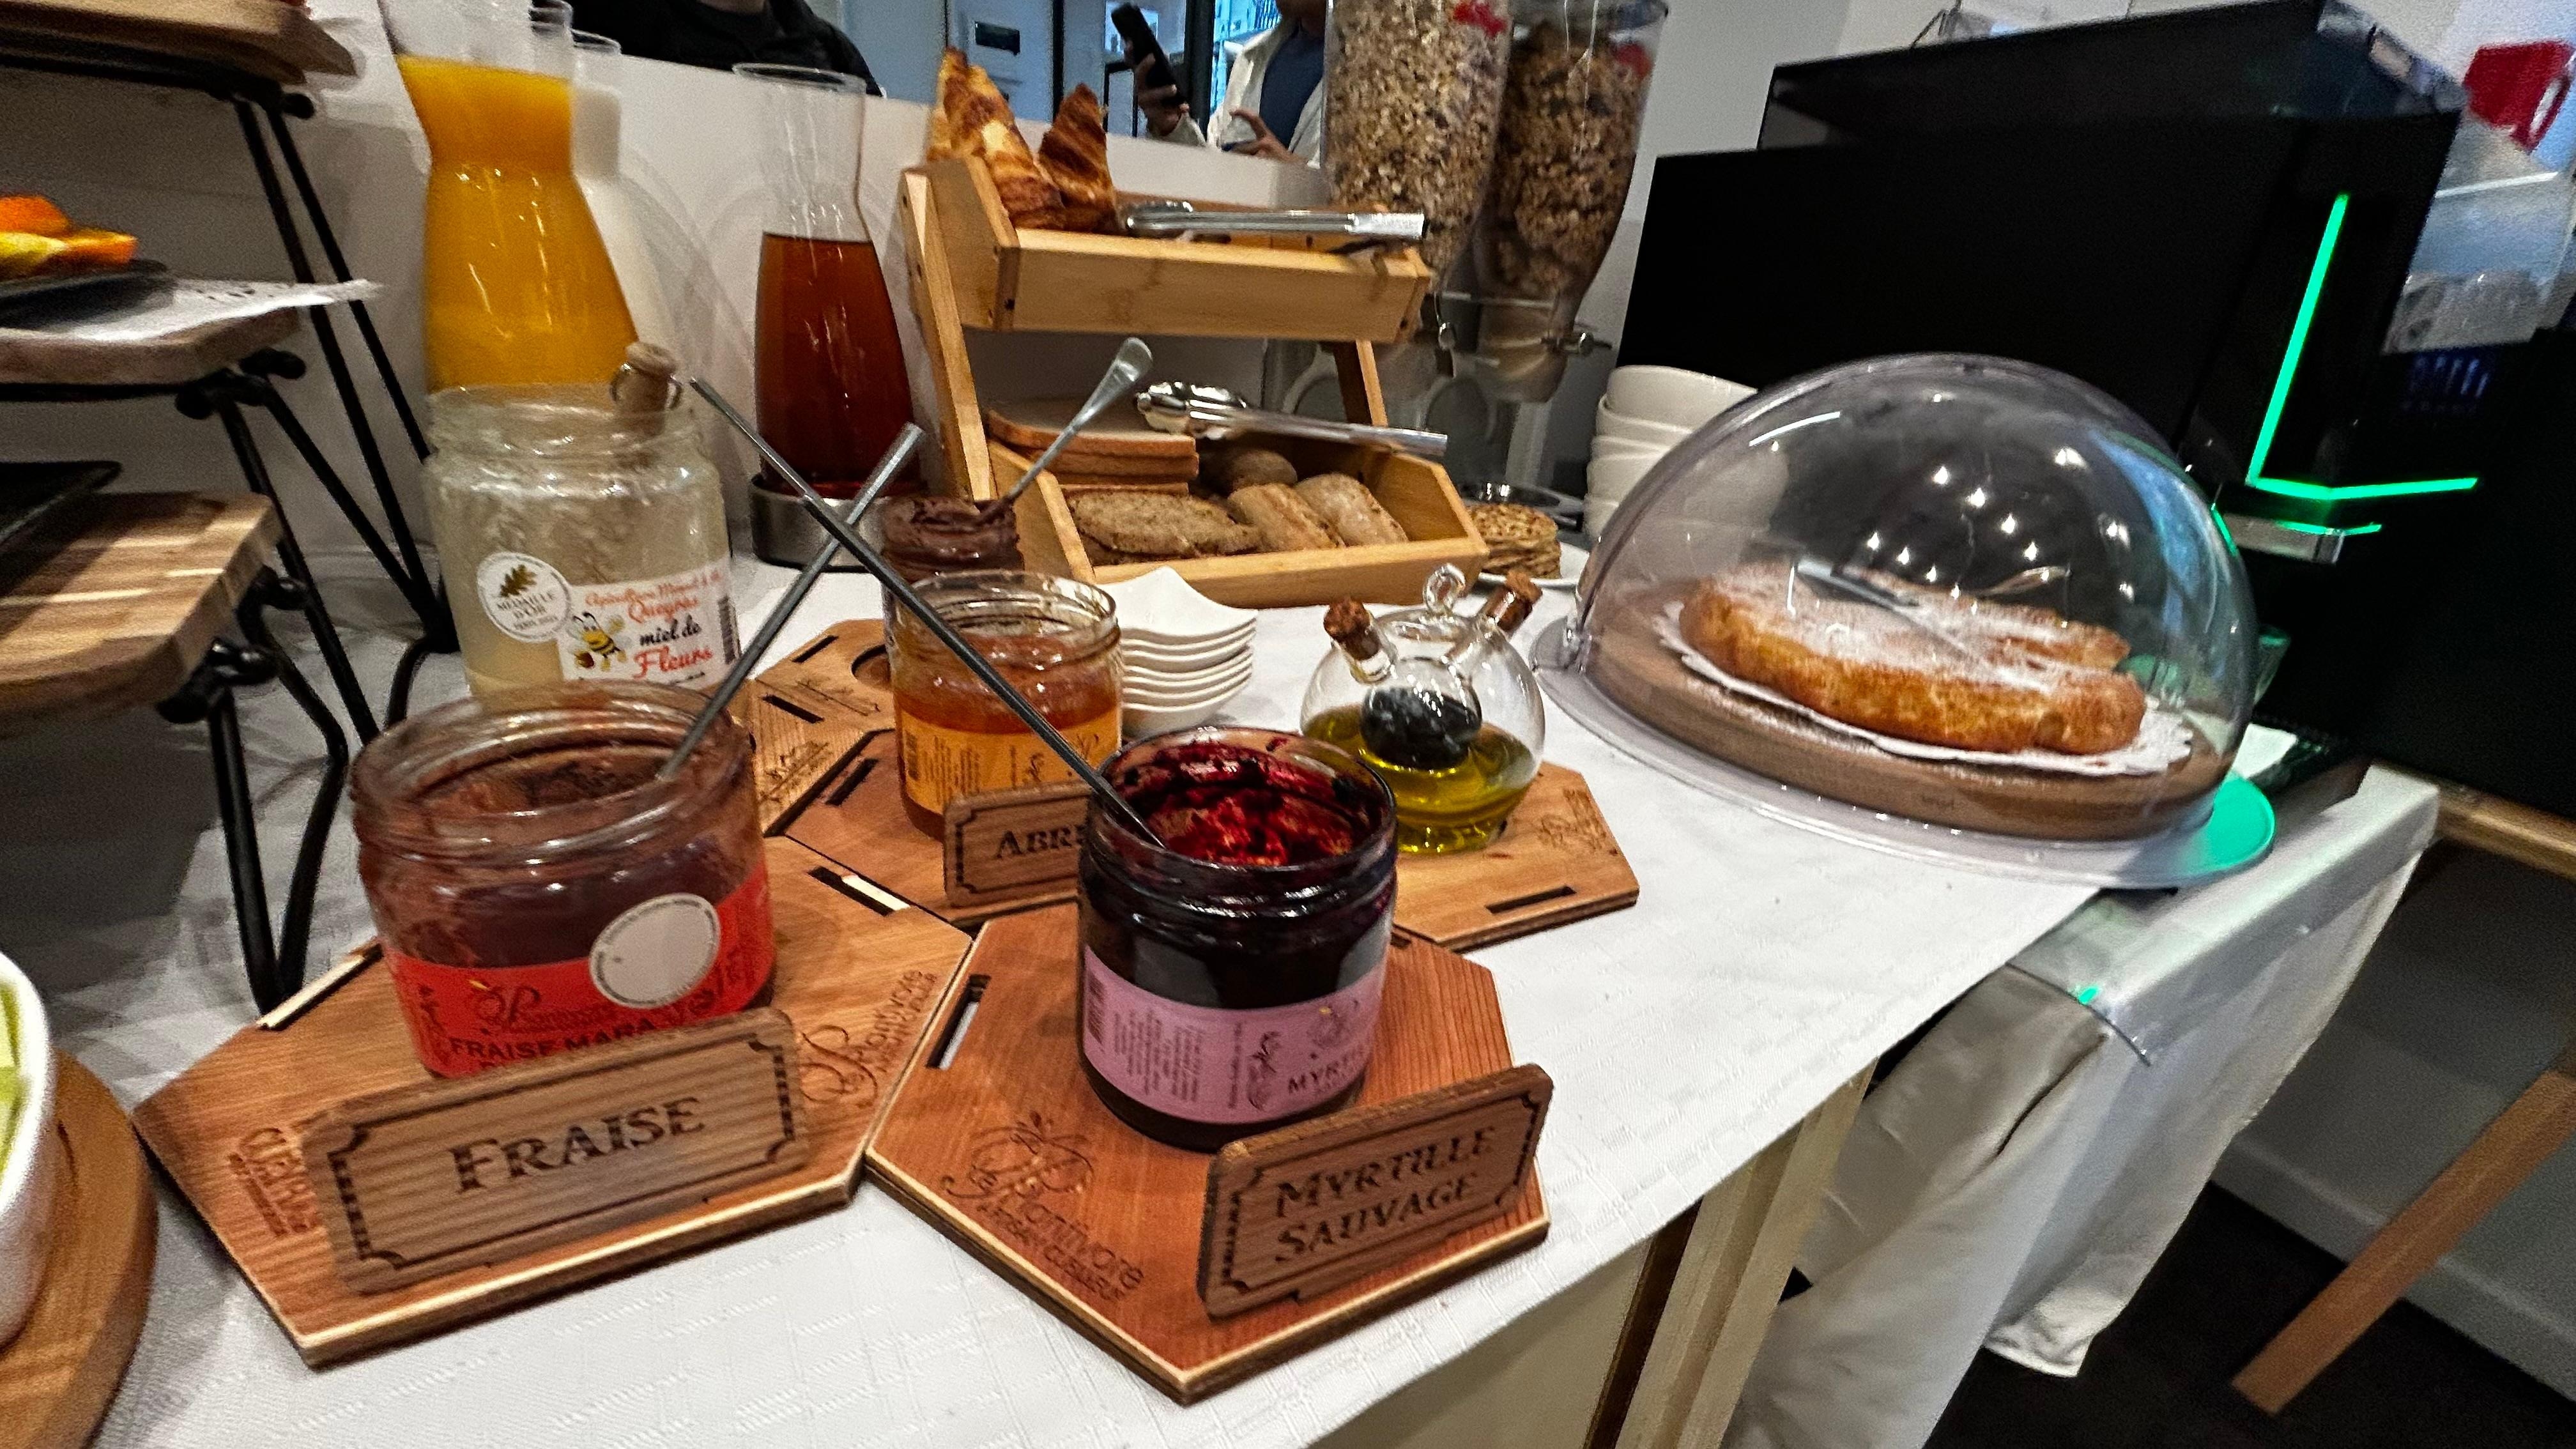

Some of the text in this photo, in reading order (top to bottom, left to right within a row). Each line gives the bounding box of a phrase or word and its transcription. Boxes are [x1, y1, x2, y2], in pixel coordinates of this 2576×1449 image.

[639, 613, 702, 646] miel de
[631, 645, 714, 680] Fleurs
[448, 1036, 555, 1061] FRAISE
[449, 1096, 705, 1193] FRAISE
[1276, 1126, 1496, 1217] MYRTILLE
[1275, 1171, 1478, 1262] SAUVAGE
